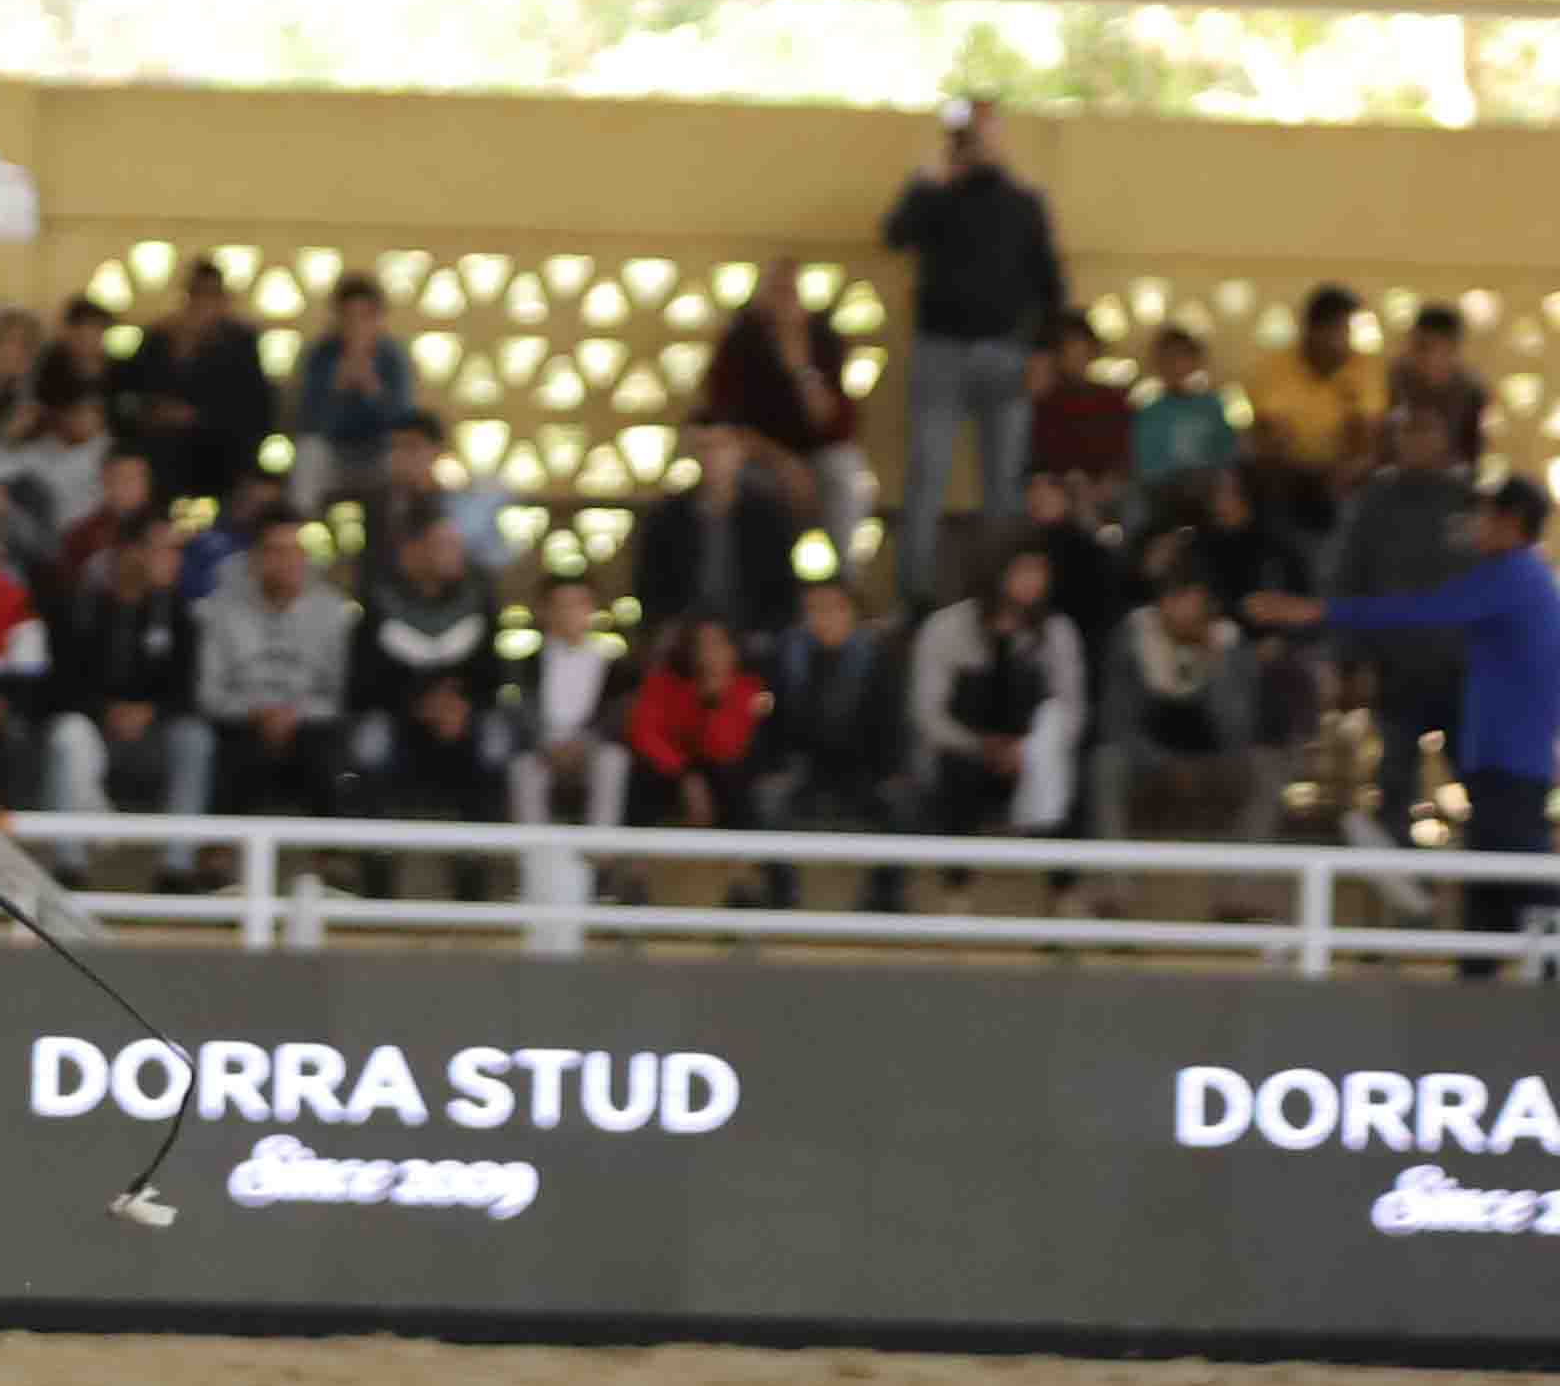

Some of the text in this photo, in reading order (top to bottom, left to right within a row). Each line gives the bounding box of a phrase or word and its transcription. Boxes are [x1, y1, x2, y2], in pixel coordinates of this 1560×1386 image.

[30, 1035, 741, 1134] DORRA STUD
[1175, 1065, 1560, 1155] DORRA
